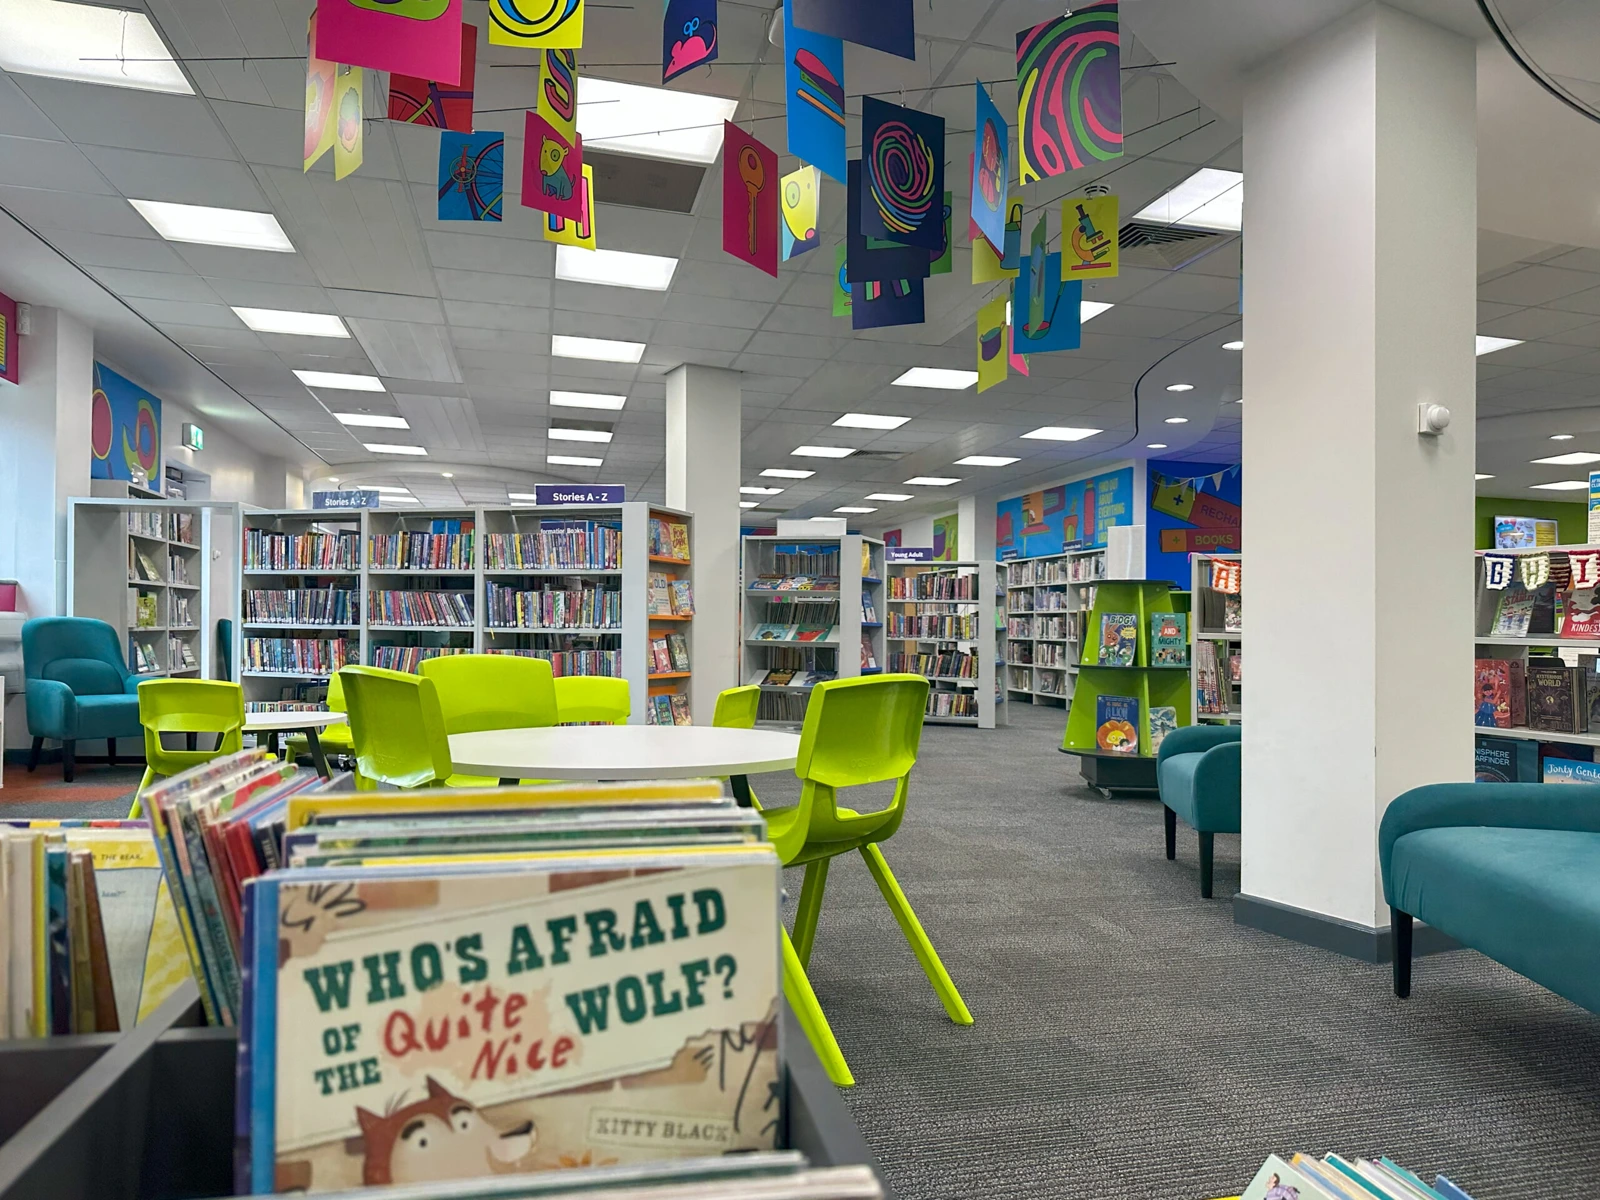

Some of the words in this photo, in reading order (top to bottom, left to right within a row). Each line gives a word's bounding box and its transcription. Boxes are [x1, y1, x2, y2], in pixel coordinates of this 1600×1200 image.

[325, 497, 349, 506] Stories
[350, 497, 355, 505] A
[361, 497, 366, 505] Z
[553, 492, 585, 501] Stories
[586, 493, 594, 501] A
[601, 493, 608, 501] Z
[1200, 504, 1238, 527] RECHA
[1195, 534, 1234, 545] BOOKS
[1214, 566, 1230, 589] A
[1490, 561, 1504, 585] G
[1525, 560, 1540, 587] H
[1576, 559, 1590, 583] I
[1163, 626, 1176, 635] AND
[1158, 637, 1182, 645] MIGHTY
[1538, 679, 1562, 687] WORLD
[1475, 755, 1510, 766] ARFINDER
[1547, 763, 1573, 777] Jonty
[303, 933, 488, 1013] WHO'S
[506, 888, 727, 976] AFRAID
[322, 1023, 361, 1056] OF
[384, 984, 527, 1058] Quite
[564, 954, 737, 1036] WOLF?
[313, 1056, 382, 1096] THE
[470, 1033, 575, 1081] Nice
[597, 1117, 656, 1138] KITTY
[662, 1121, 729, 1143] BLACK
